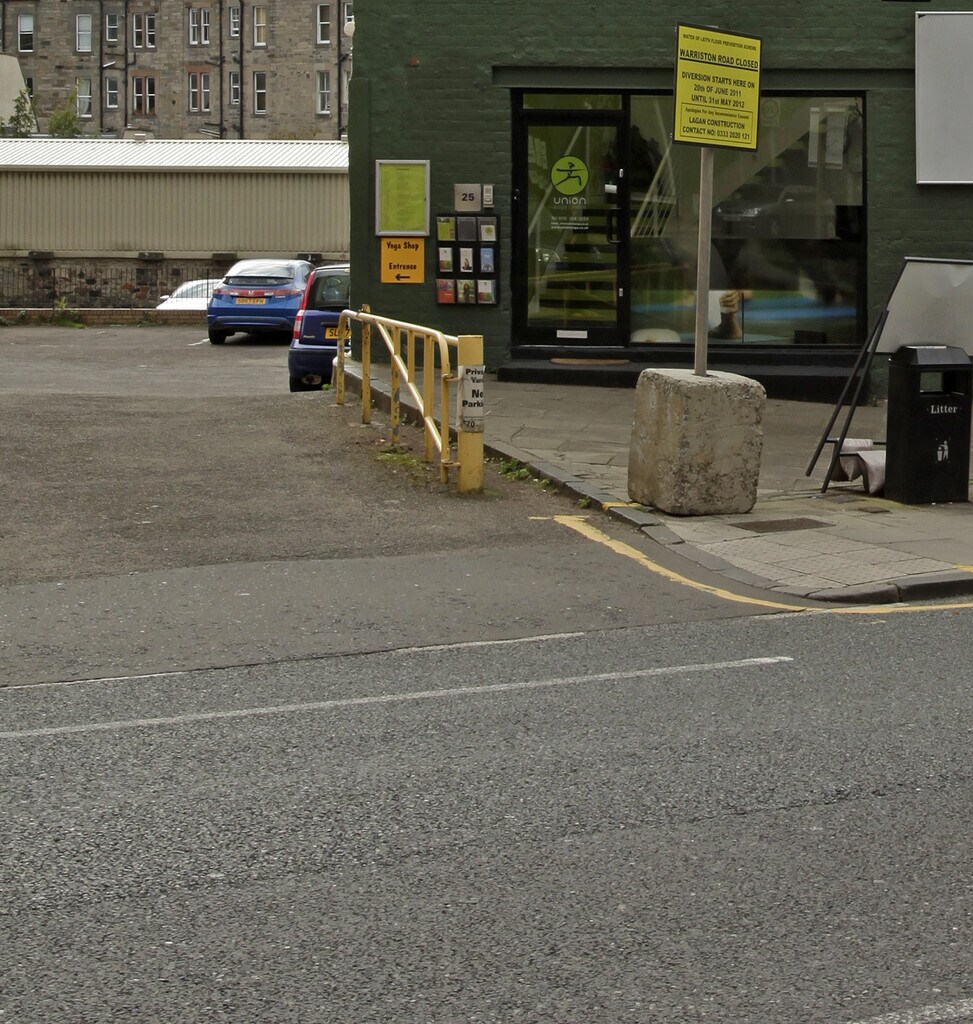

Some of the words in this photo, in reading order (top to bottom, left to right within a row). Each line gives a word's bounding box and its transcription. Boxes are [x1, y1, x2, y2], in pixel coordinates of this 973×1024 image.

[680, 48, 717, 63] WARRISTON
[718, 54, 734, 65] ROAD
[736, 57, 759, 69] CLOSED
[682, 71, 711, 82] DIVERSION
[712, 75, 732, 86] STARTS
[732, 79, 746, 87] HERE
[747, 81, 756, 89] ON
[694, 84, 705, 92] 20th
[714, 86, 728, 95] JUNE
[730, 89, 742, 98] 2011
[691, 94, 708, 104] UNTIL
[720, 98, 732, 106] MAY
[732, 100, 745, 108] 2012
[688, 116, 706, 126] LAGAN
[706, 118, 746, 130] CONSTRUCTION
[682, 126, 706, 135] CONTACT
[462, 193, 475, 202] 25
[553, 197, 587, 205] union
[386, 241, 402, 252] Yoga
[403, 241, 420, 252] Shop
[388, 262, 418, 270] Entrance
[930, 404, 958, 414] Litter
